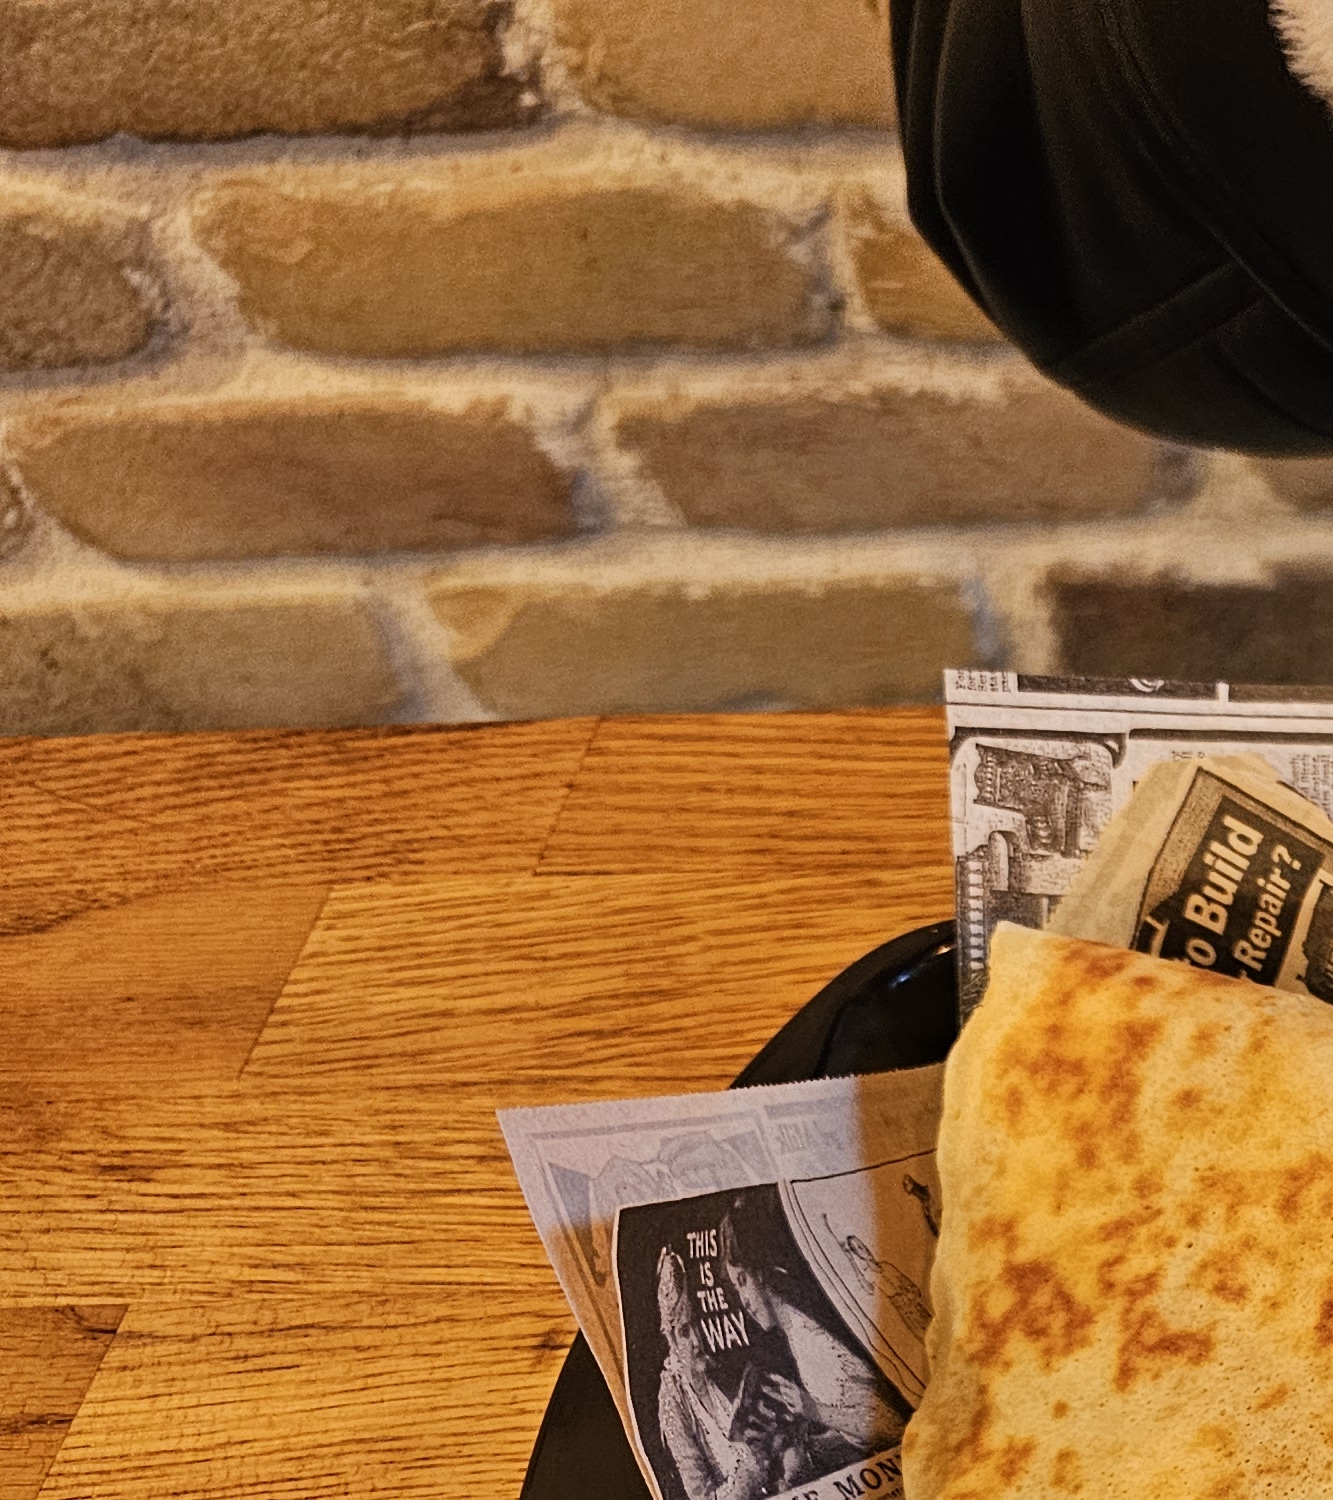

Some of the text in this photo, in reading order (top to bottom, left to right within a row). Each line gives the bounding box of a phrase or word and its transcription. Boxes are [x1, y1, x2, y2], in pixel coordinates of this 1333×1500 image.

[1186, 815, 1263, 937] Build
[1233, 840, 1303, 981] Repair?
[685, 1226, 719, 1260] THIS
[697, 1261, 715, 1286] IS
[695, 1286, 729, 1312] THE
[701, 1311, 752, 1352] WAY
